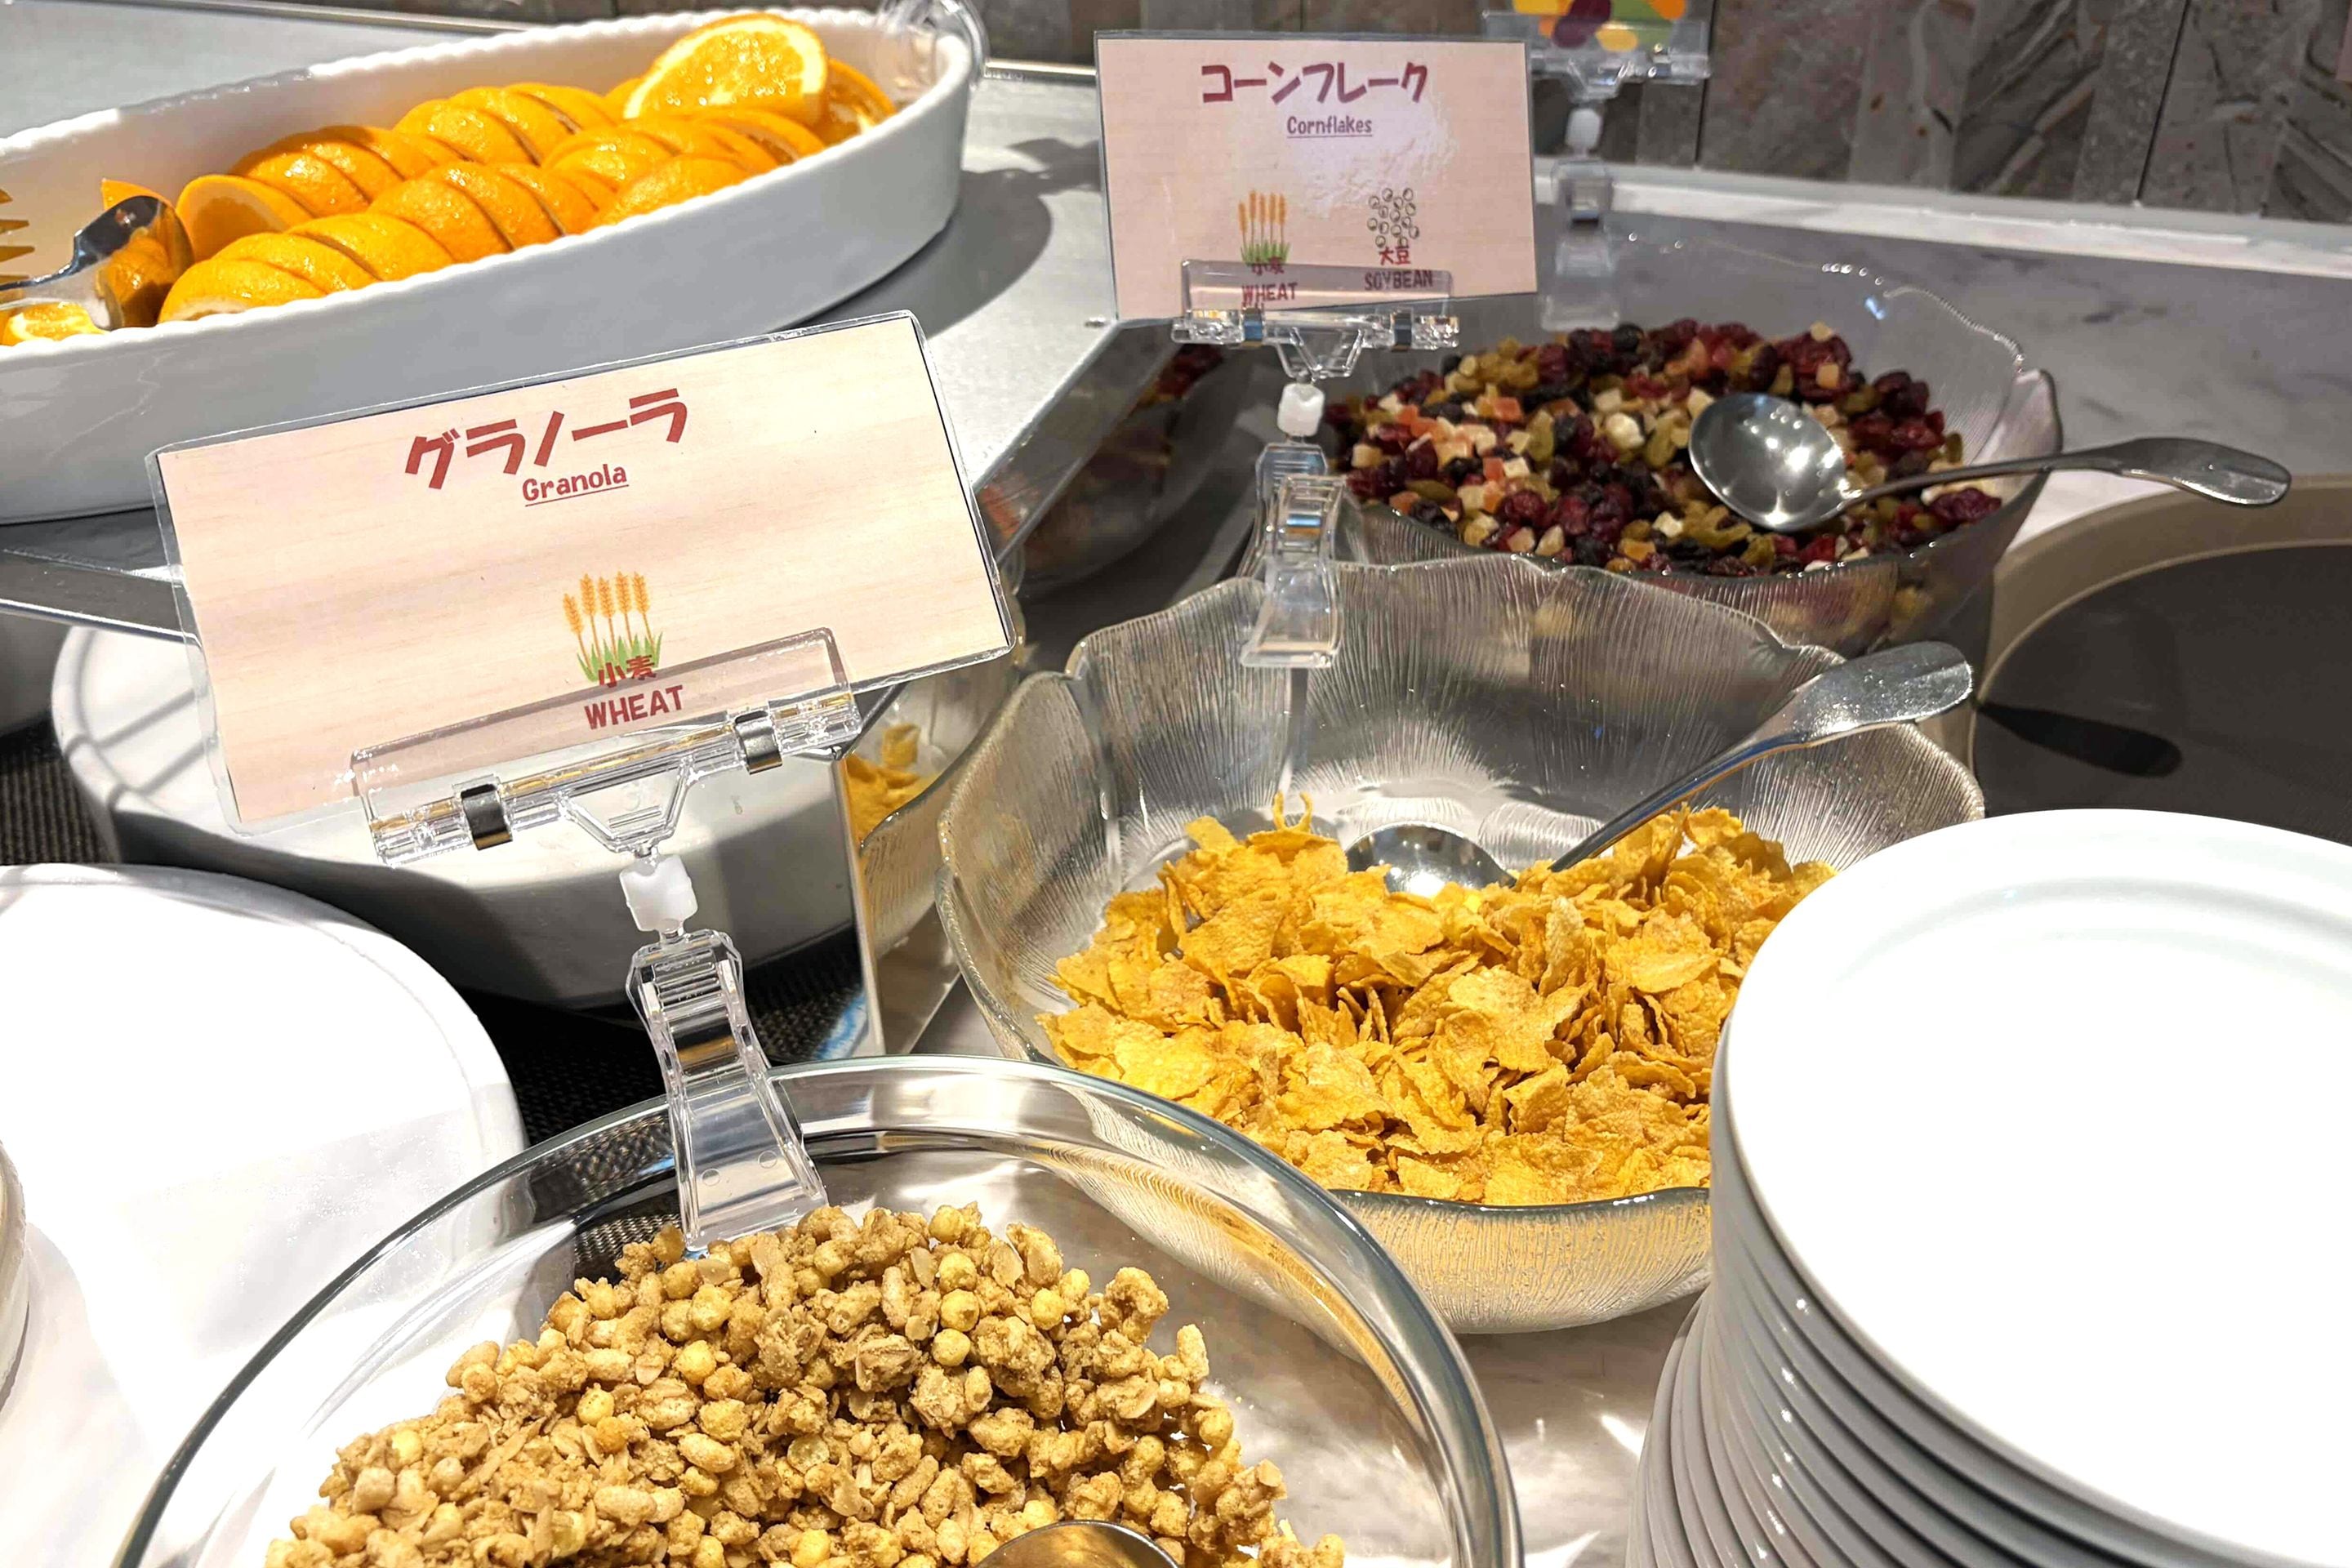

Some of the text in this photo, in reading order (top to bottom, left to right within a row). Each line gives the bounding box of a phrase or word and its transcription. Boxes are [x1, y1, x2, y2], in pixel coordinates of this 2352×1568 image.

[1200, 61, 1428, 104] コーンフレーク
[1286, 115, 1373, 135] Cornflakes
[1379, 245, 1411, 265] 大豆
[1241, 282, 1298, 305] WHEAT
[1364, 270, 1433, 291] SOYBEAN
[404, 388, 688, 490] グラノーラ
[522, 464, 628, 502] Granola
[598, 654, 657, 688] 小麦
[584, 684, 684, 730] WHEAT
